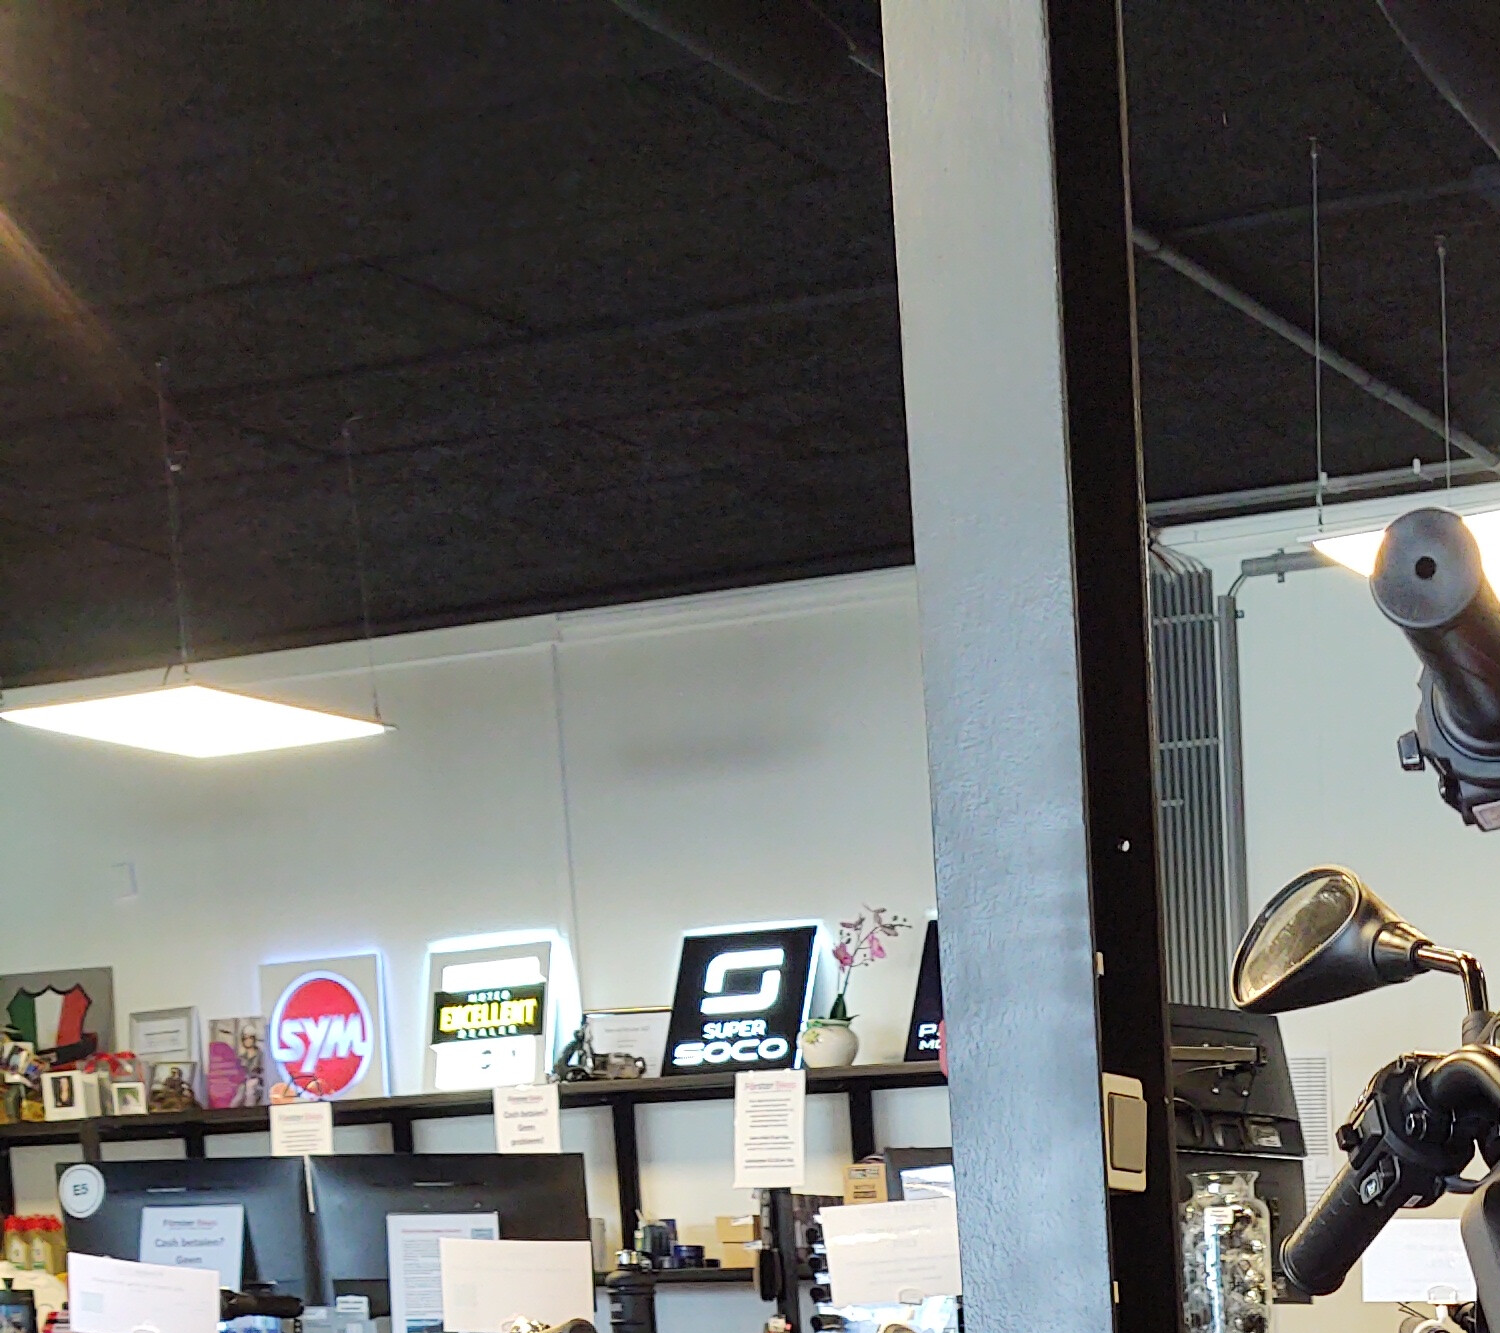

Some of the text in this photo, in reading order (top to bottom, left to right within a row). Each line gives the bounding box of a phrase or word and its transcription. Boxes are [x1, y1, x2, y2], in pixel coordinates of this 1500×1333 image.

[440, 998, 537, 1032] EXCELLENT
[702, 1019, 768, 1040] SUPER
[277, 1014, 367, 1075] SYM
[673, 1037, 789, 1066] SOCO
[73, 1184, 88, 1196] E5
